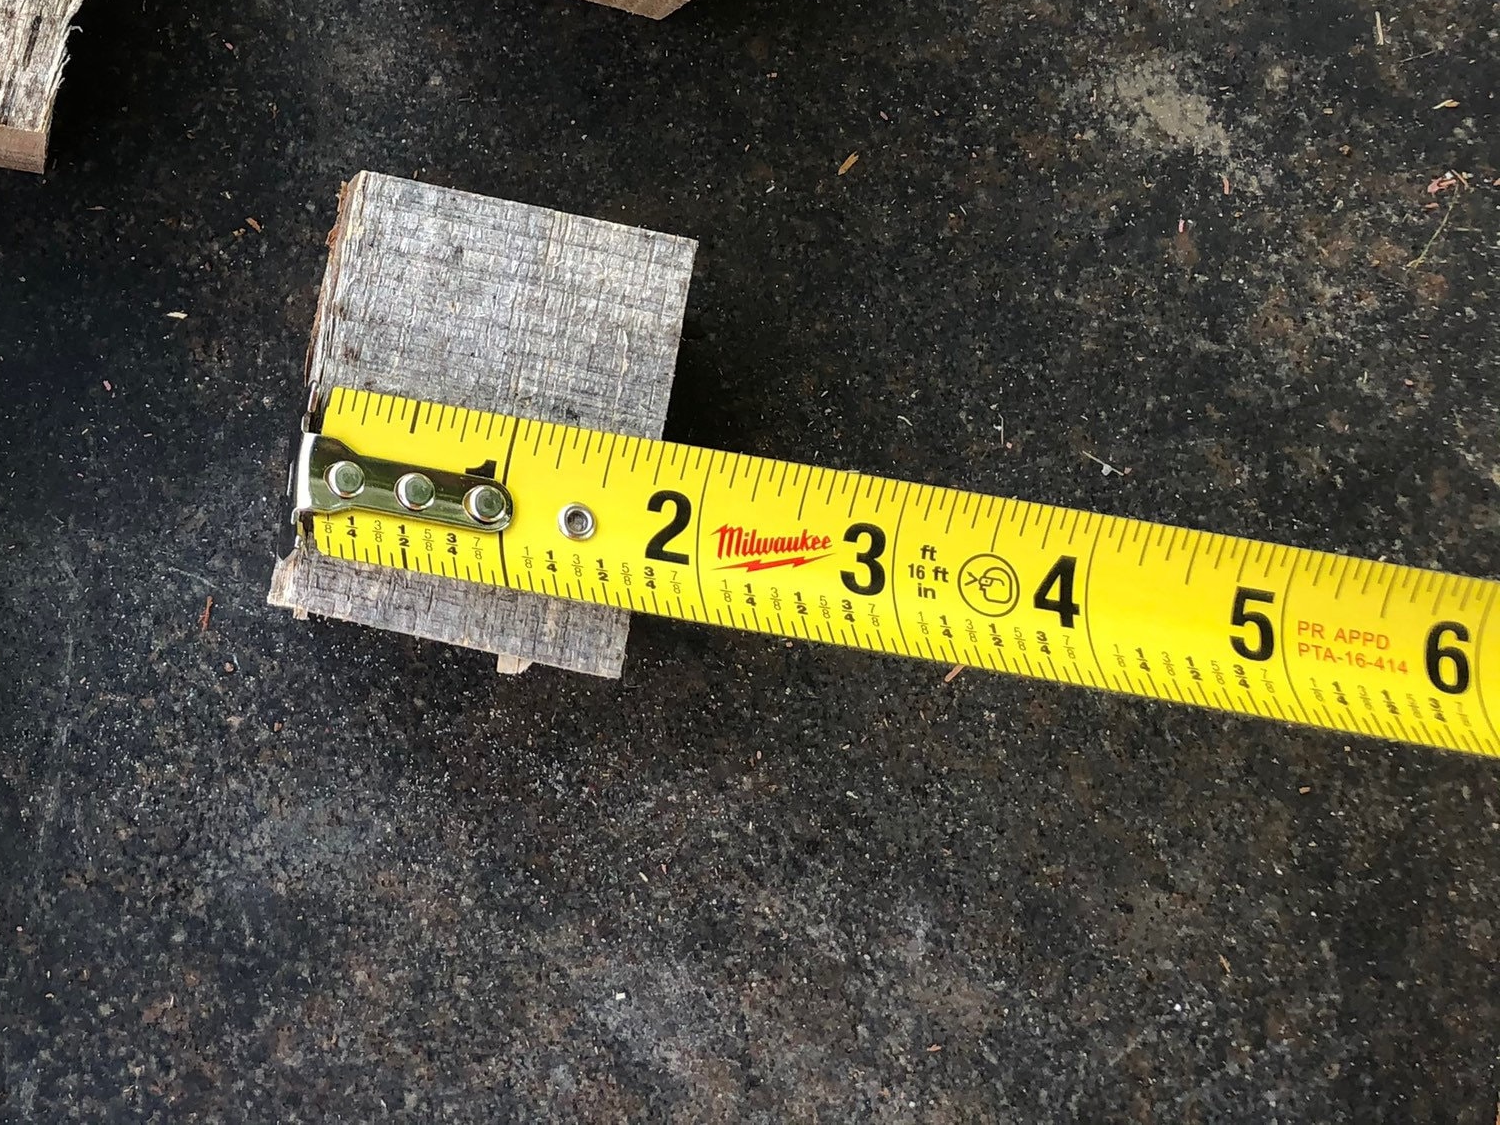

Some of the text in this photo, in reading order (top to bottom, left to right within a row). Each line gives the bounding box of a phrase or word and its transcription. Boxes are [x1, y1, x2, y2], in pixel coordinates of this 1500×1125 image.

[645, 490, 691, 565] 2
[710, 524, 832, 559] Milwaukee
[840, 522, 886, 596] 3
[921, 545, 937, 561] ft
[908, 564, 949, 583] 16 ft
[917, 583, 936, 599] in
[1033, 554, 1080, 628] 4
[1230, 586, 1276, 661] 5
[1298, 621, 1389, 650] PR APPD
[1298, 643, 1408, 675] PTA-16-414
[1426, 621, 1471, 695] 6
